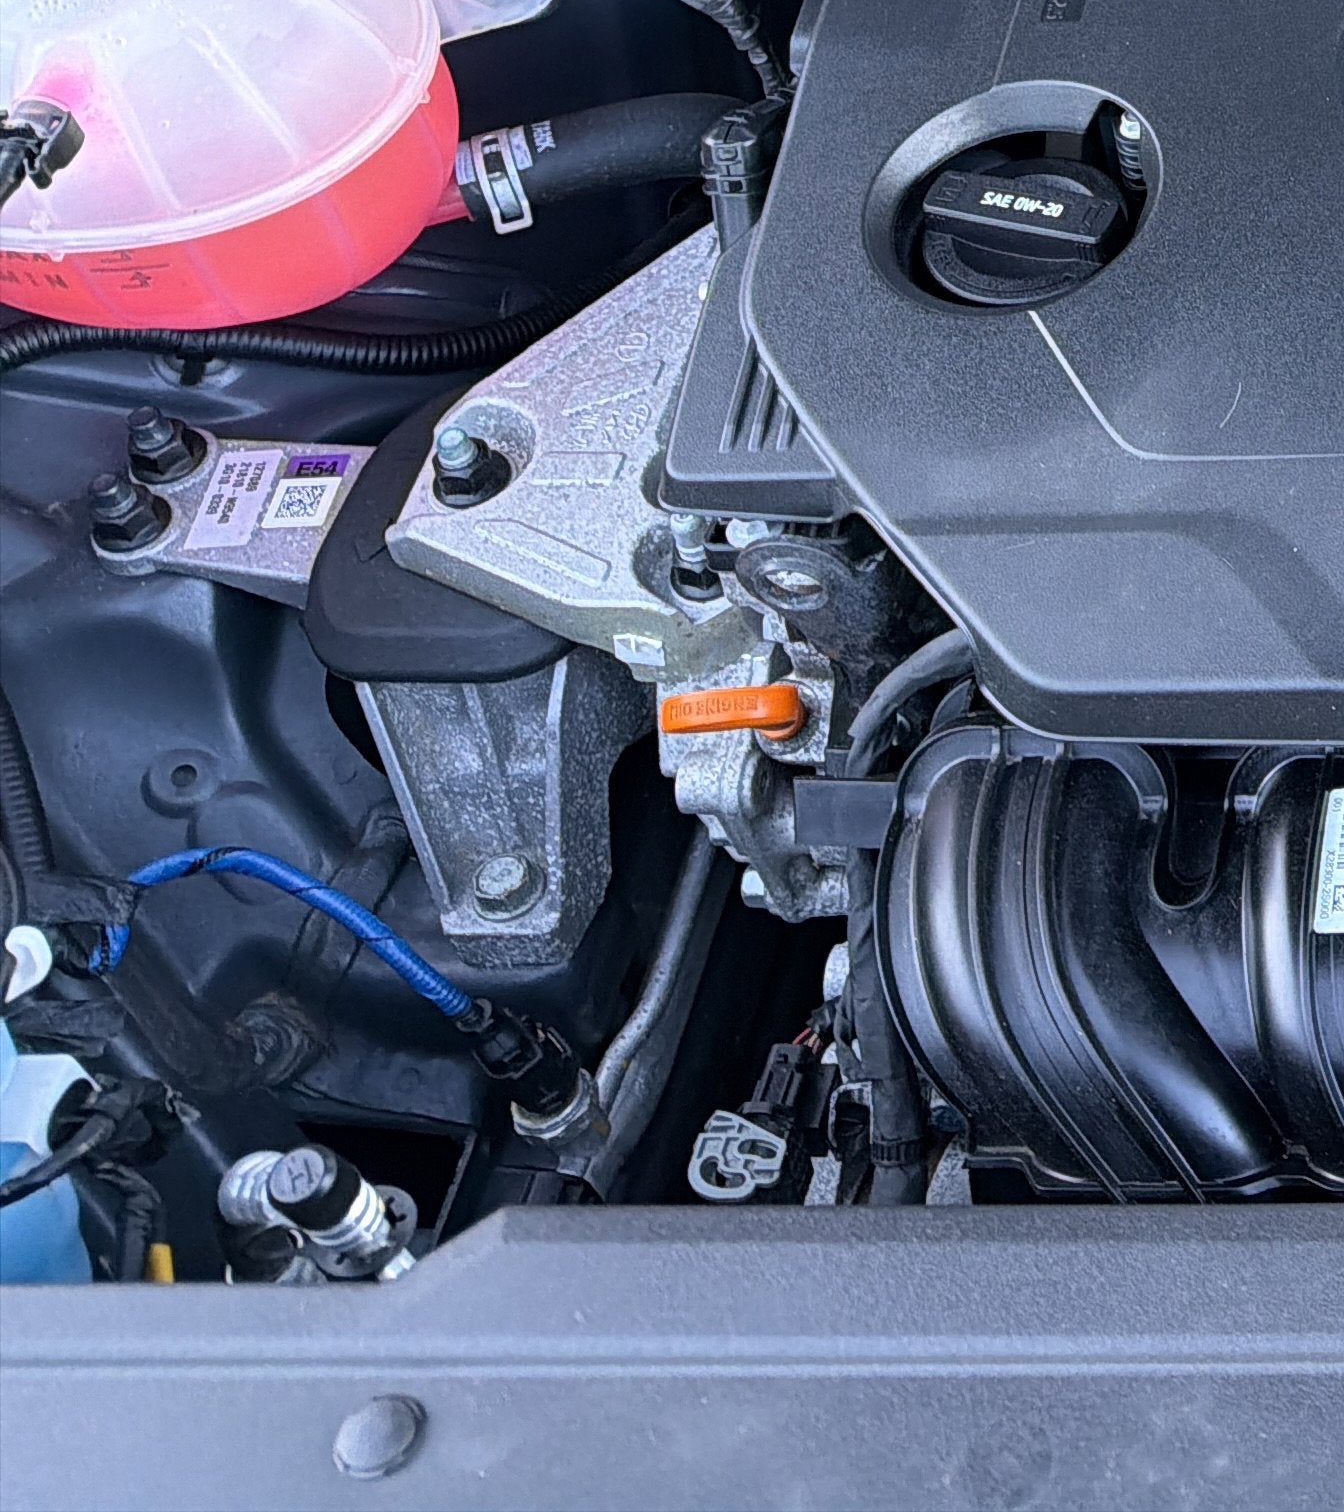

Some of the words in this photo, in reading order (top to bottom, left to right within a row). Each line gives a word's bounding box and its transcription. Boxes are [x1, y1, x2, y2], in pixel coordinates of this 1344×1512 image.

[980, 191, 1014, 209] SAE
[1013, 194, 1064, 218] 0W-20
[297, 460, 338, 477] E54
[670, 701, 692, 722] OIL
[695, 694, 759, 717] ENGINE
